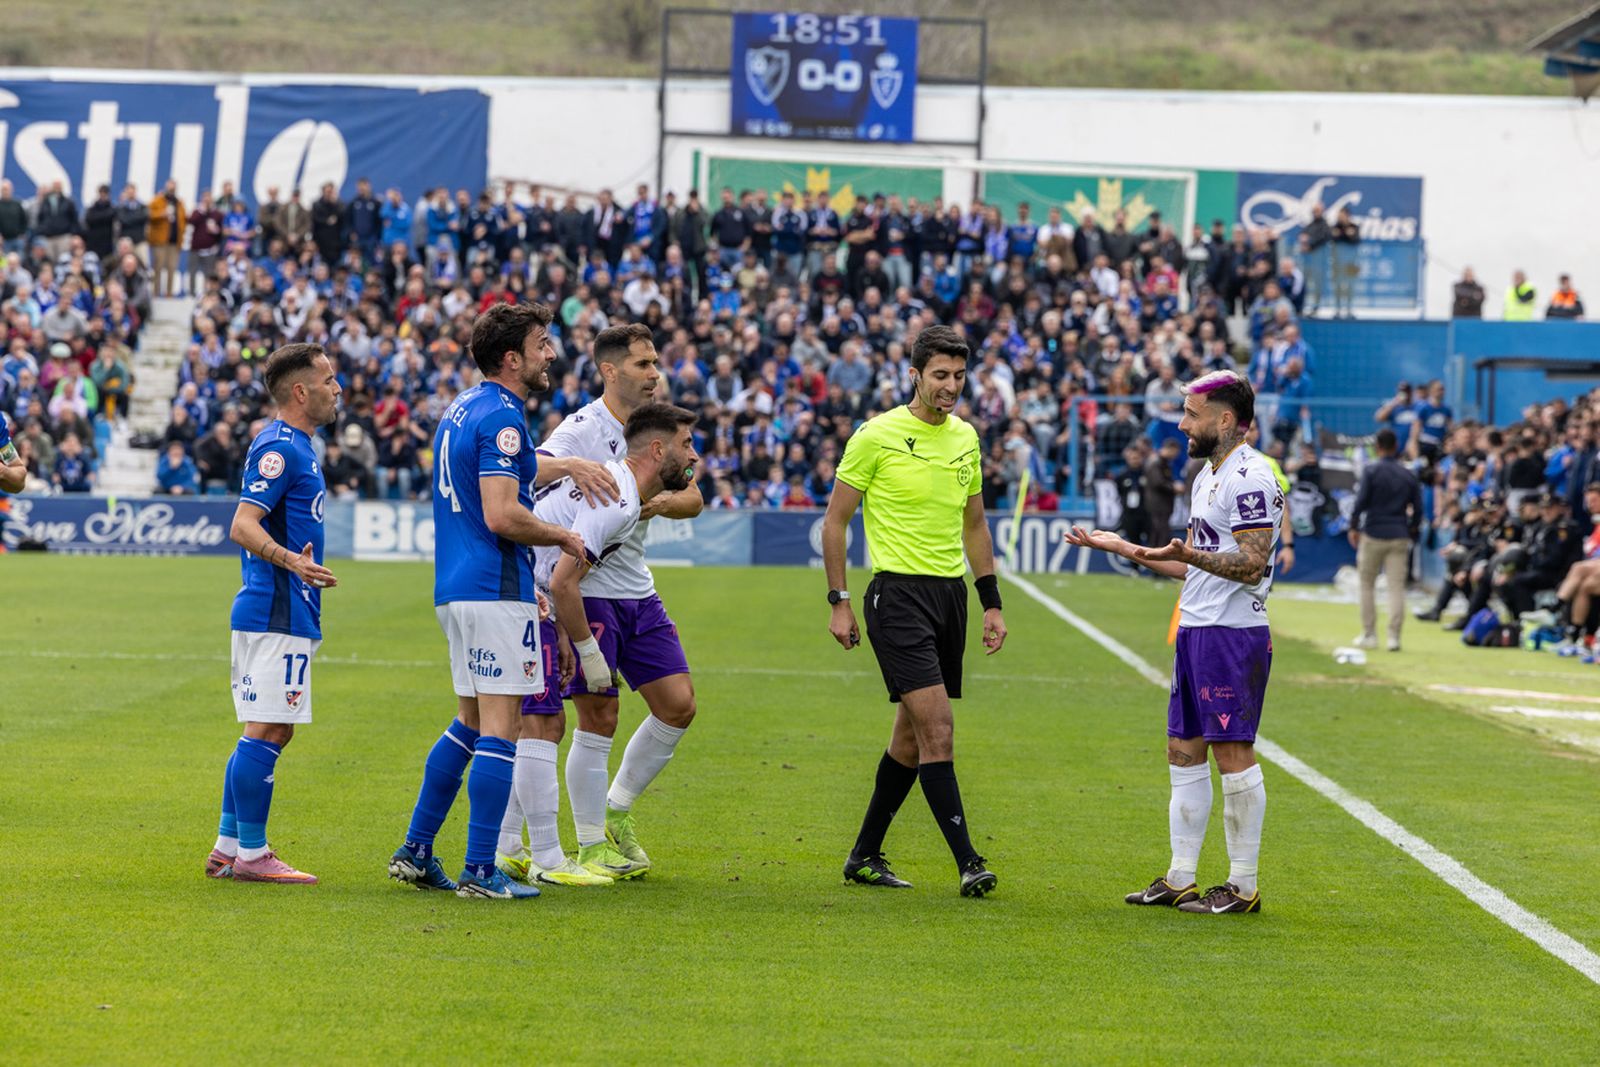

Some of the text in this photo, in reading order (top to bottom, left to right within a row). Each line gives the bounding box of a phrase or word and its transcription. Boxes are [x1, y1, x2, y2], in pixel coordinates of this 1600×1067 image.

[769, 13, 887, 46] 18:51
[797, 58, 863, 92] 0-0
[438, 429, 463, 513] 4
[522, 620, 536, 652] 4
[283, 653, 309, 686] 17
